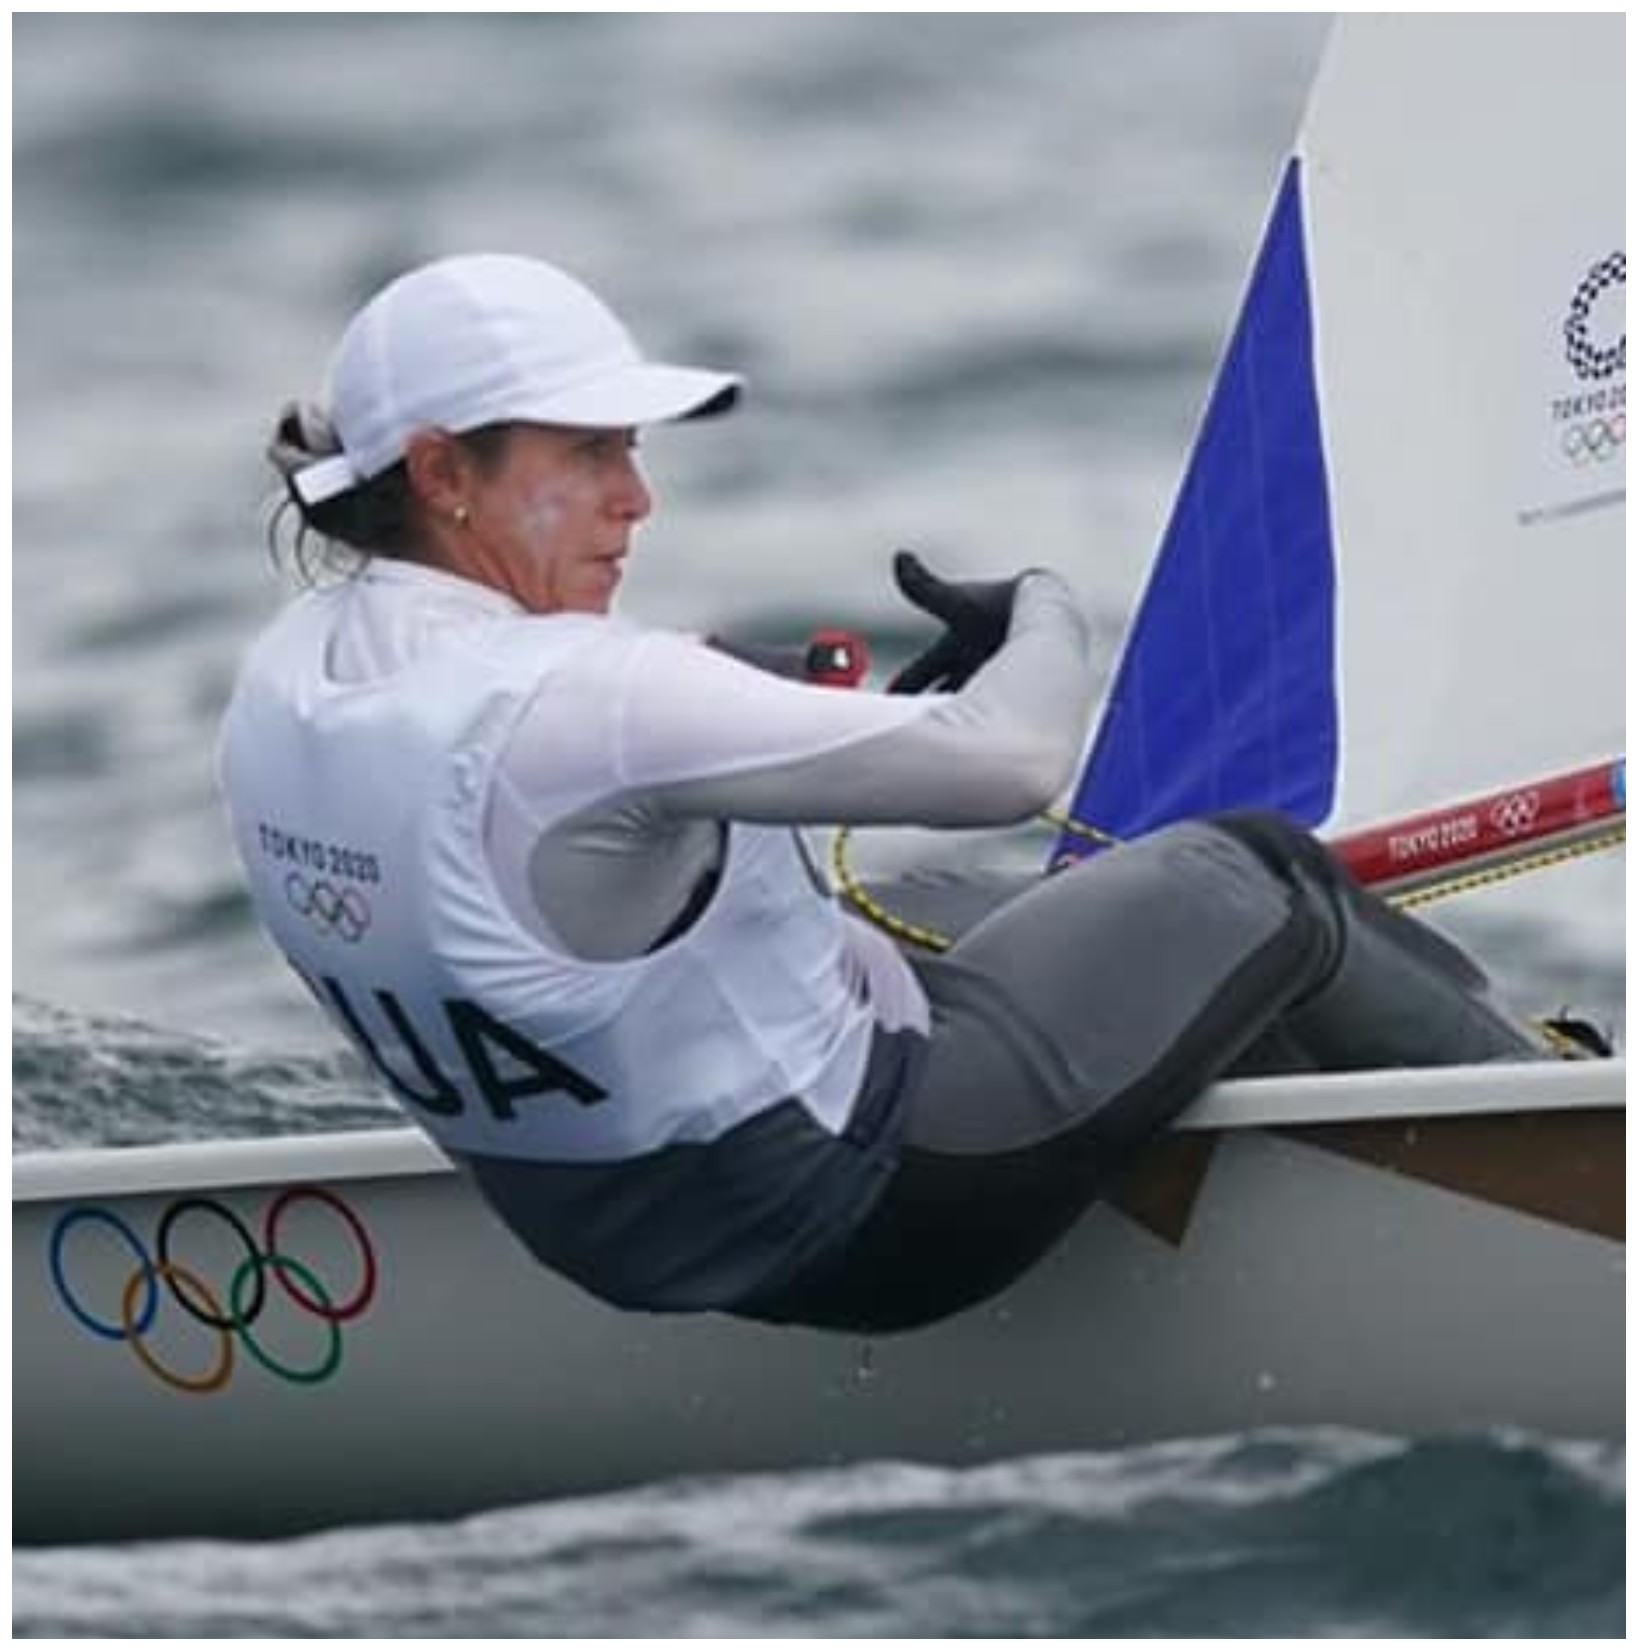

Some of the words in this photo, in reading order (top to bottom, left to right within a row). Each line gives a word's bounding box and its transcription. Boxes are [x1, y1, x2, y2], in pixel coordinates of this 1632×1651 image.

[1552, 389, 1606, 420] TOKYO
[258, 822, 326, 869] TOKYO
[328, 844, 381, 885] 2020
[1388, 826, 1438, 860] TOKYO
[1441, 813, 1477, 850] 2020
[292, 965, 609, 1120] UA
